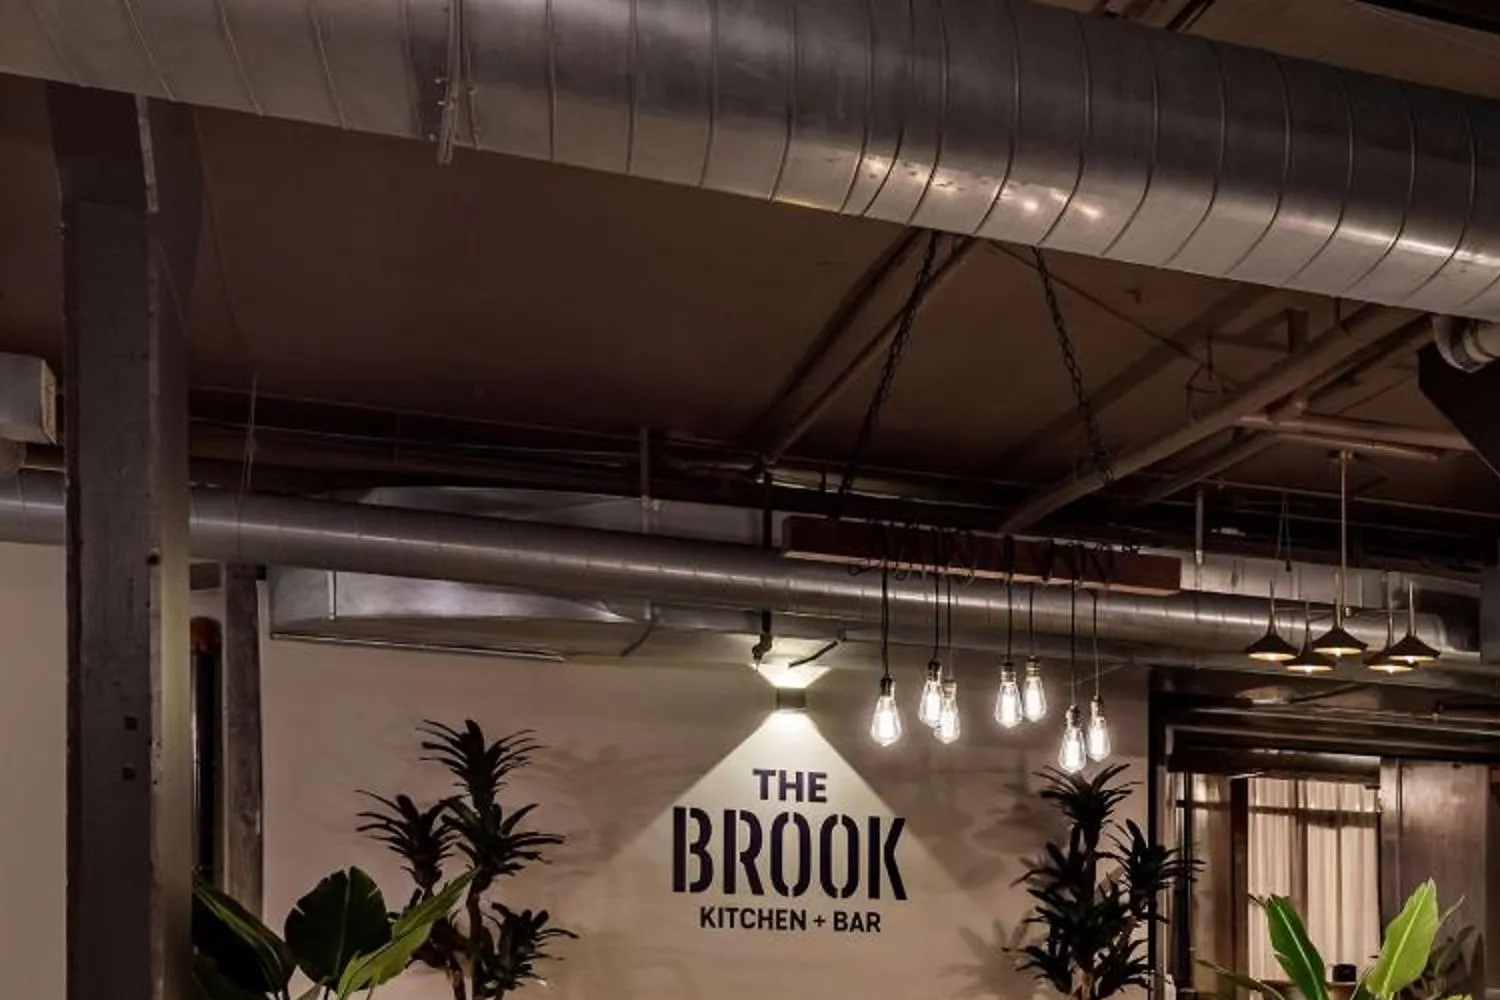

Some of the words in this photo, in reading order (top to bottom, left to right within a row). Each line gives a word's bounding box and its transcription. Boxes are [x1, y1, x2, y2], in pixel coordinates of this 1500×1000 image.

[752, 768, 828, 803] THE
[672, 806, 908, 901] BROOK
[700, 906, 807, 932] KITCHEN
[813, 914, 826, 928] +
[833, 911, 882, 933] BAR
